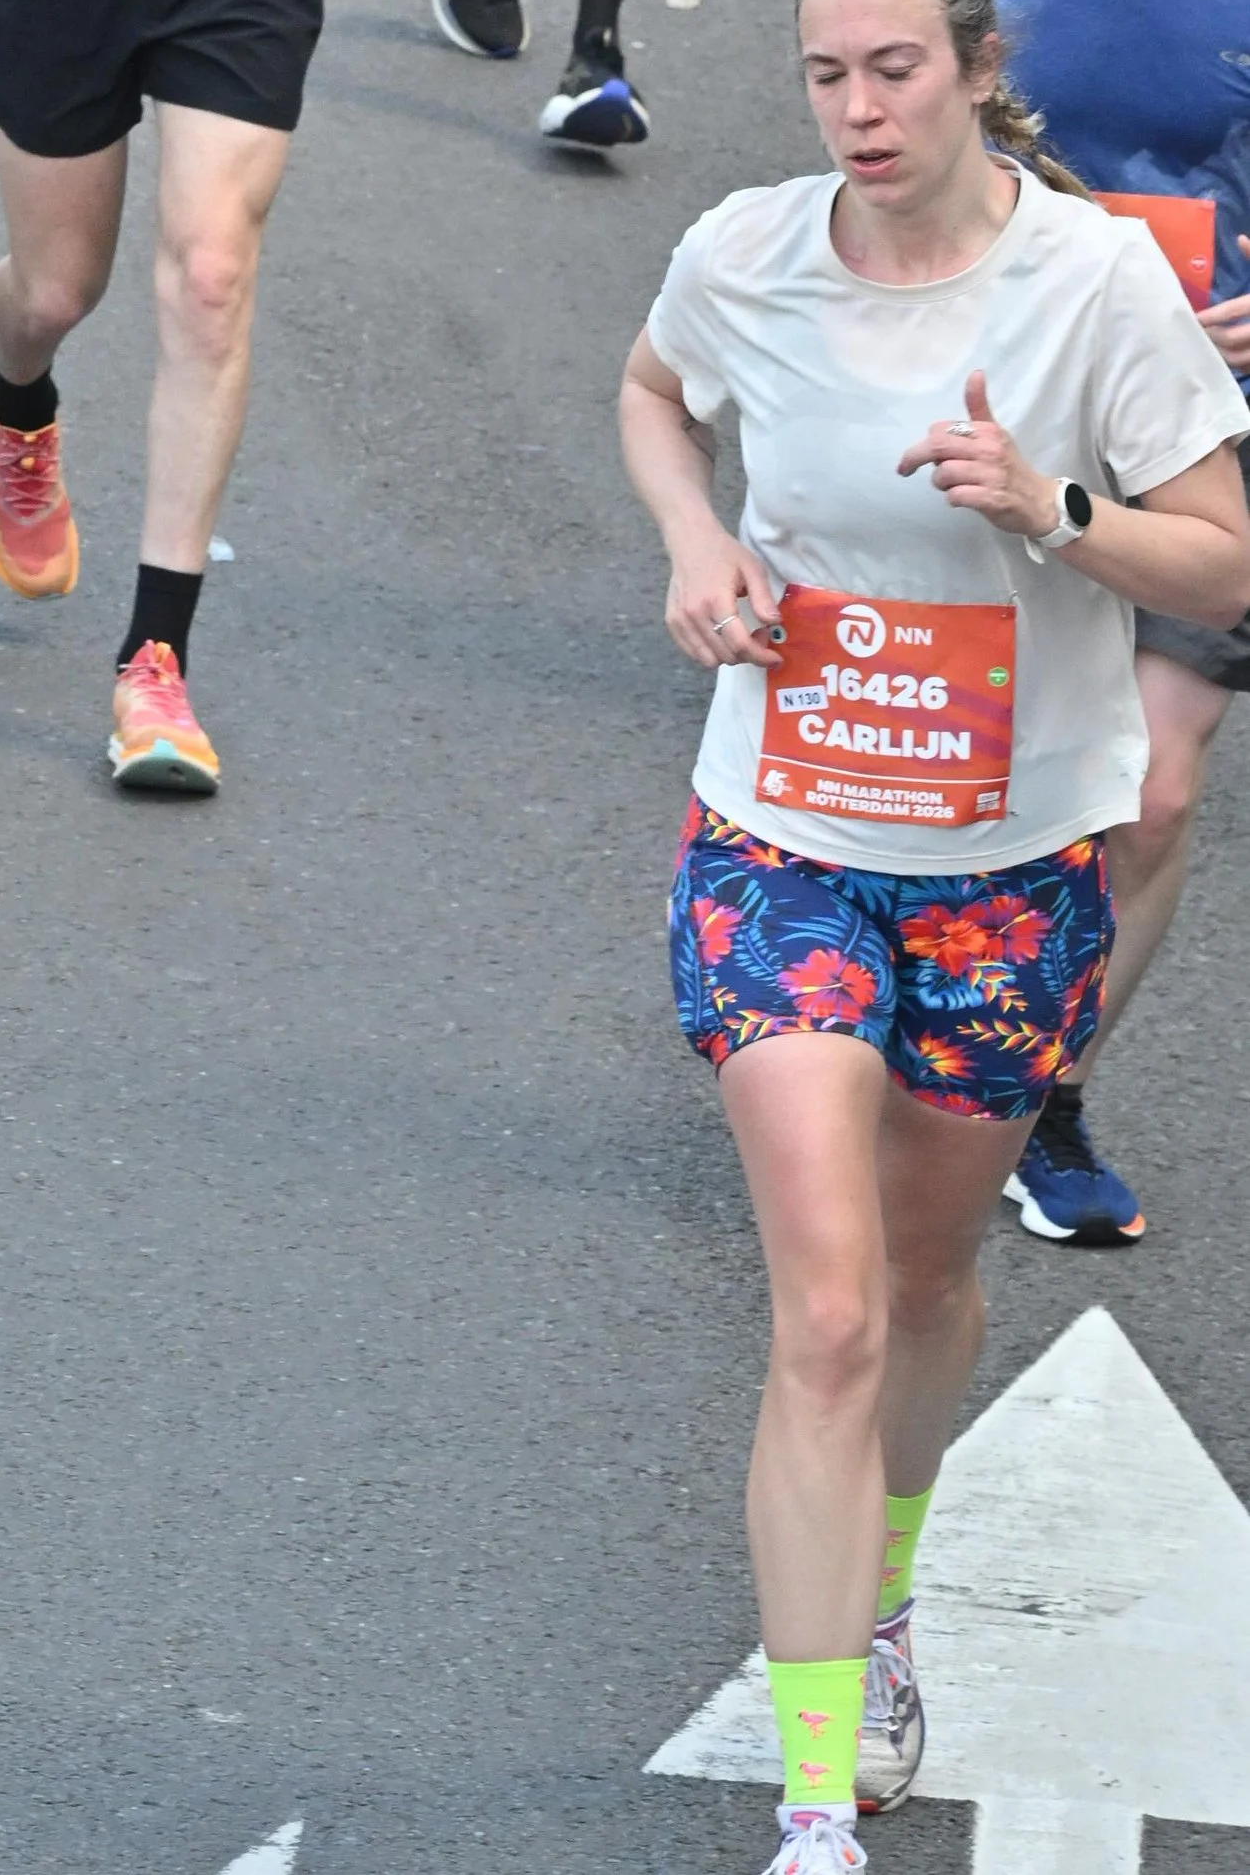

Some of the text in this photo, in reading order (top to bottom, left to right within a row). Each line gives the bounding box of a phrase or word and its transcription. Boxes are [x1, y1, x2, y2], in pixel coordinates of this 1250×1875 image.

[894, 625, 933, 646] NN
[784, 691, 821, 707] N 130
[820, 663, 949, 711] 16426
[797, 713, 972, 760] CARLIJN
[804, 790, 956, 819] ROTTERDAM 2026
[816, 778, 944, 805] NN MARATHON
